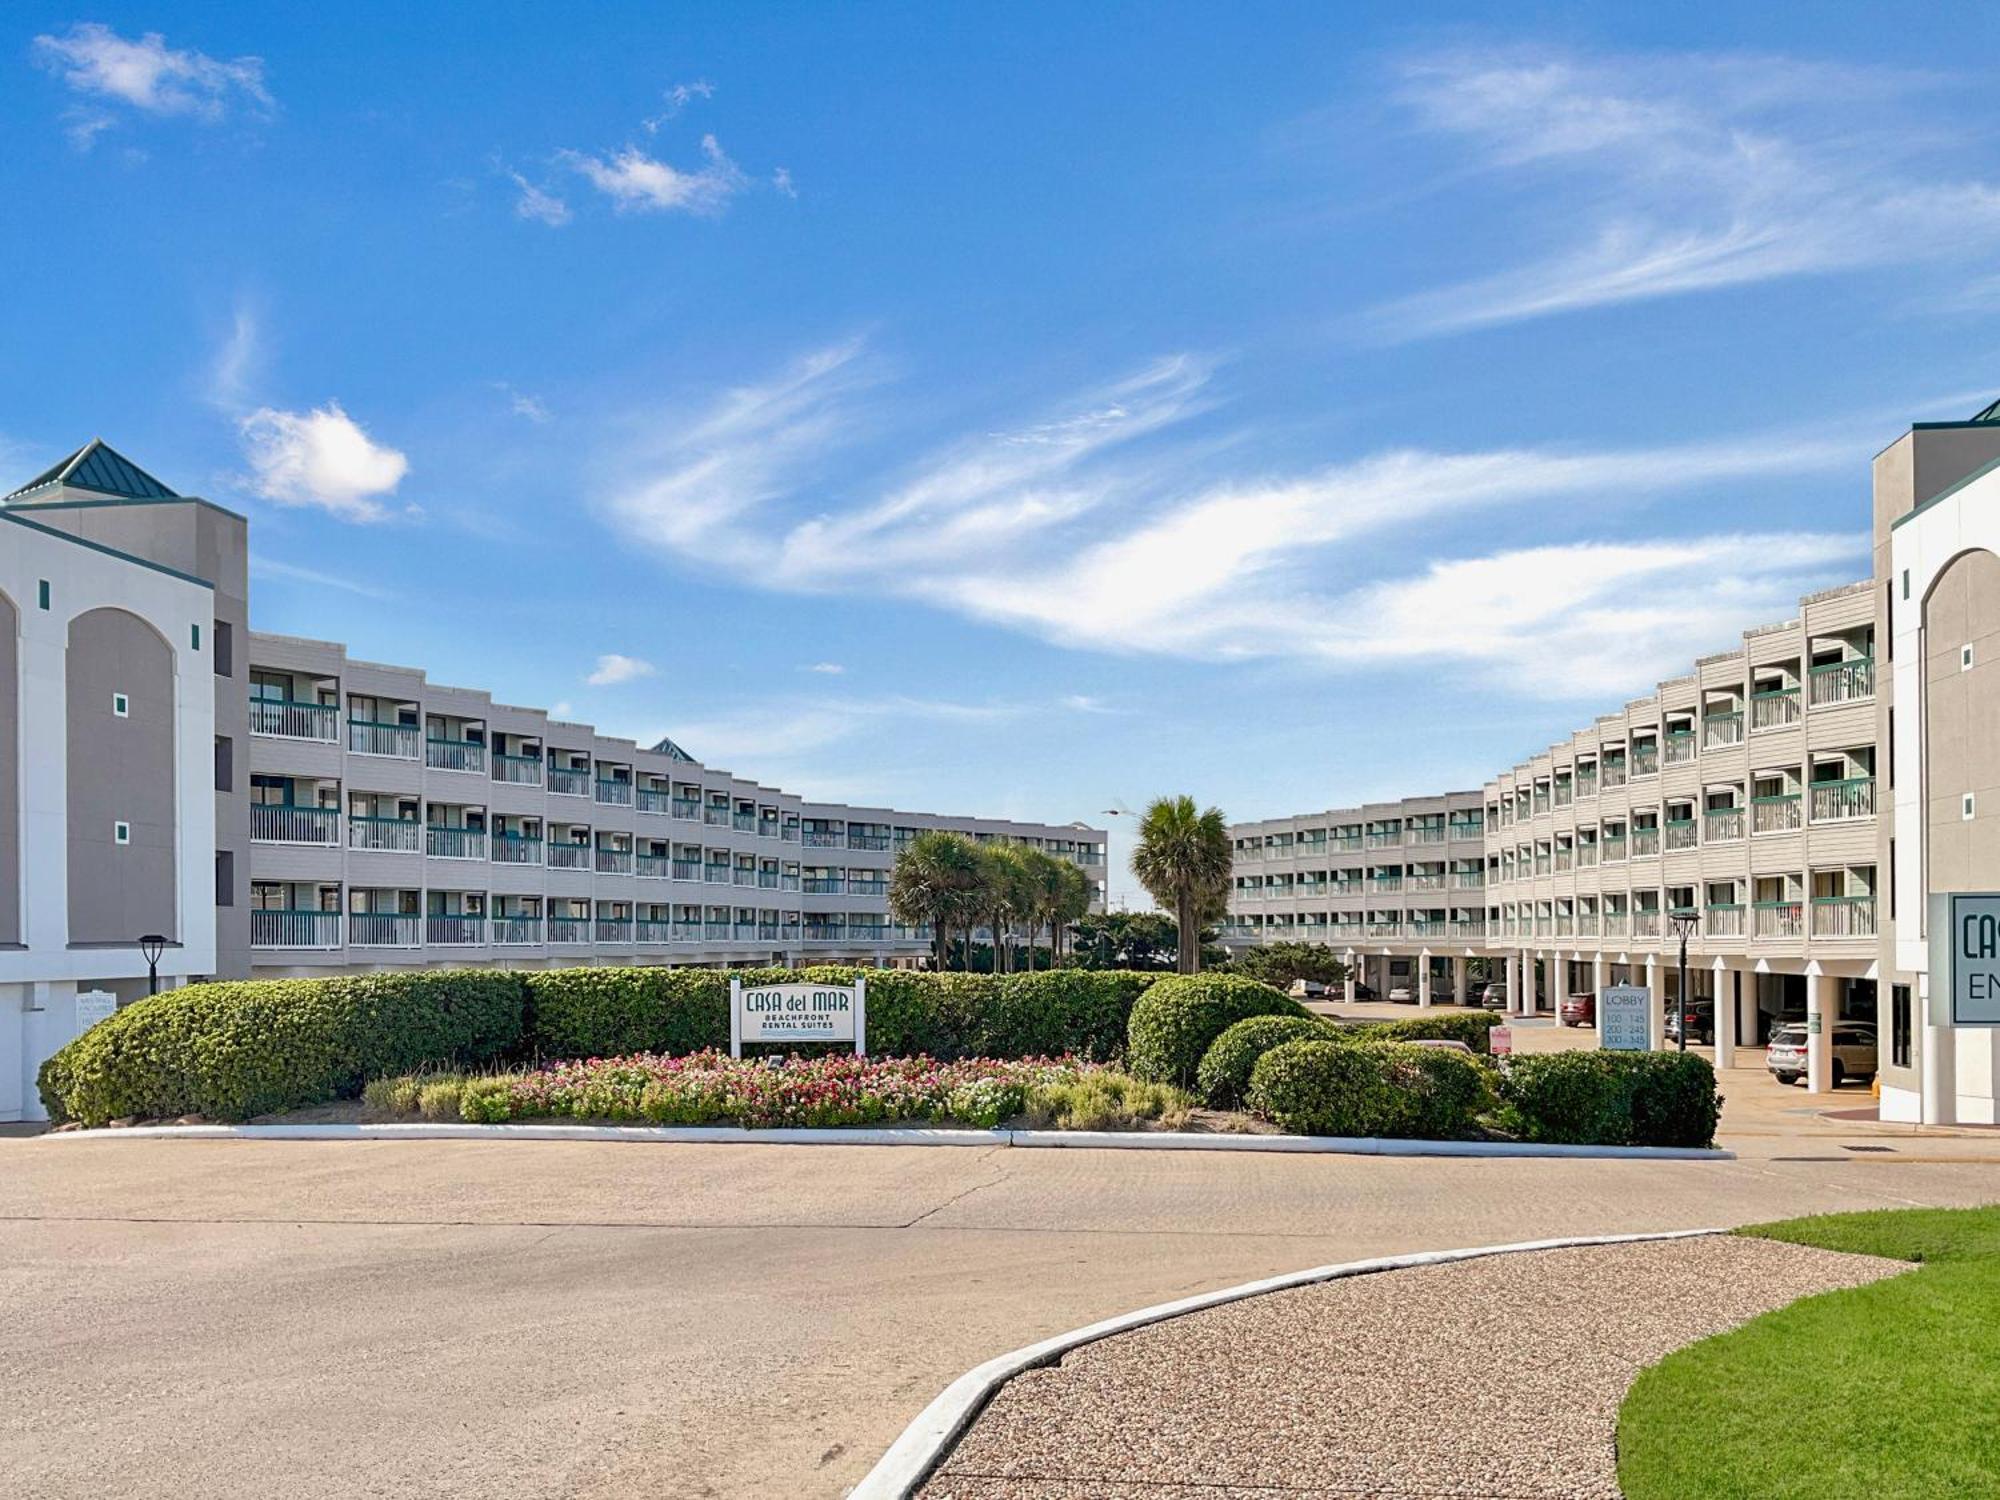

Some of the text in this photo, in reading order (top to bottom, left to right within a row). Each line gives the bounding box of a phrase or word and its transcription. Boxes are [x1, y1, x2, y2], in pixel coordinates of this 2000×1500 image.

[1963, 914, 2000, 959] CA
[746, 991, 849, 1012] CASA del MAR
[1606, 994, 1645, 1005] LOBBY
[1607, 1014, 1622, 1023] 100
[1606, 1024, 1622, 1034] 200
